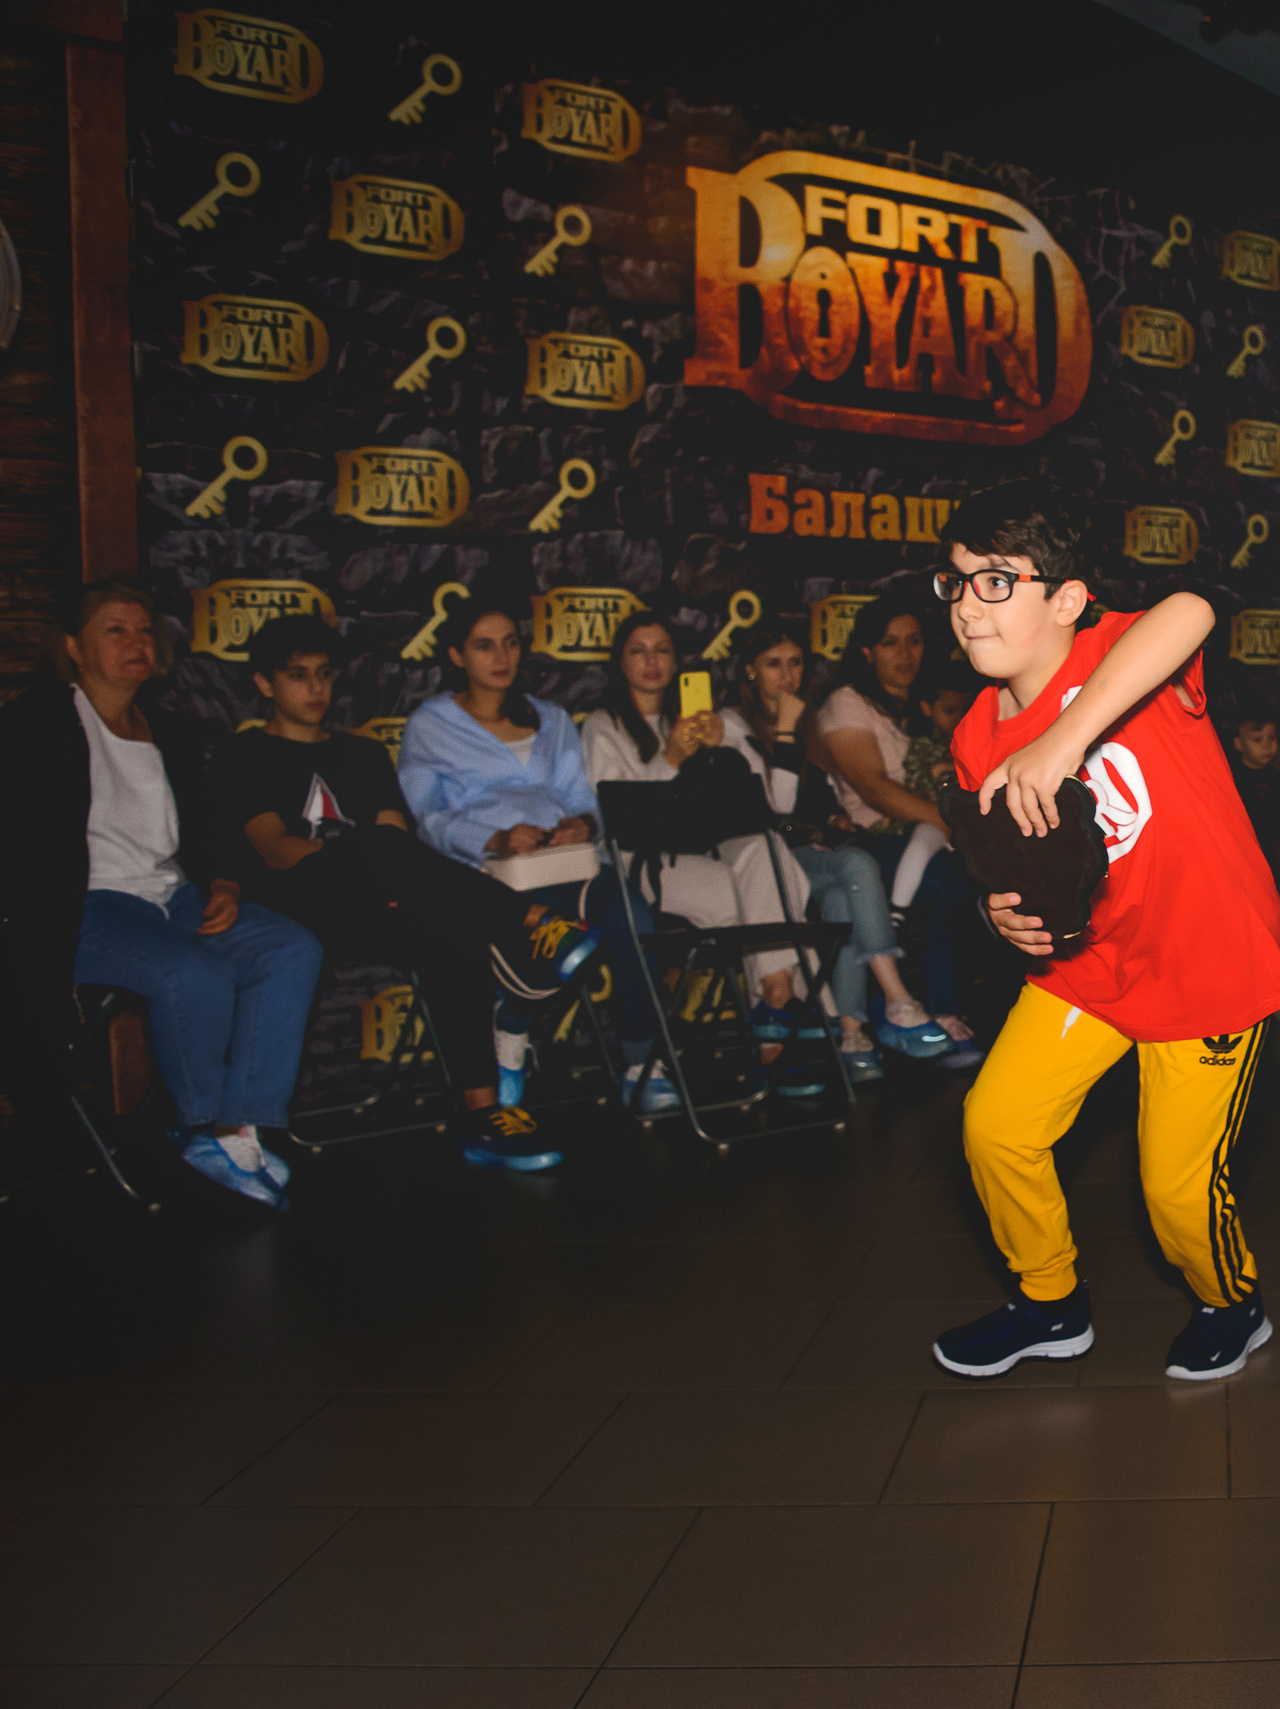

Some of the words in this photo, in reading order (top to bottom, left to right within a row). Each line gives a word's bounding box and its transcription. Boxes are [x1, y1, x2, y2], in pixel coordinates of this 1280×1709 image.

[173, 8, 325, 104] BOYARD
[215, 19, 281, 46] FORT
[804, 184, 990, 264] FORT
[180, 293, 330, 382] BOYARD
[684, 150, 1093, 446] BOYARD
[748, 473, 961, 543] Балаш
[1199, 1055, 1236, 1066] adidas
